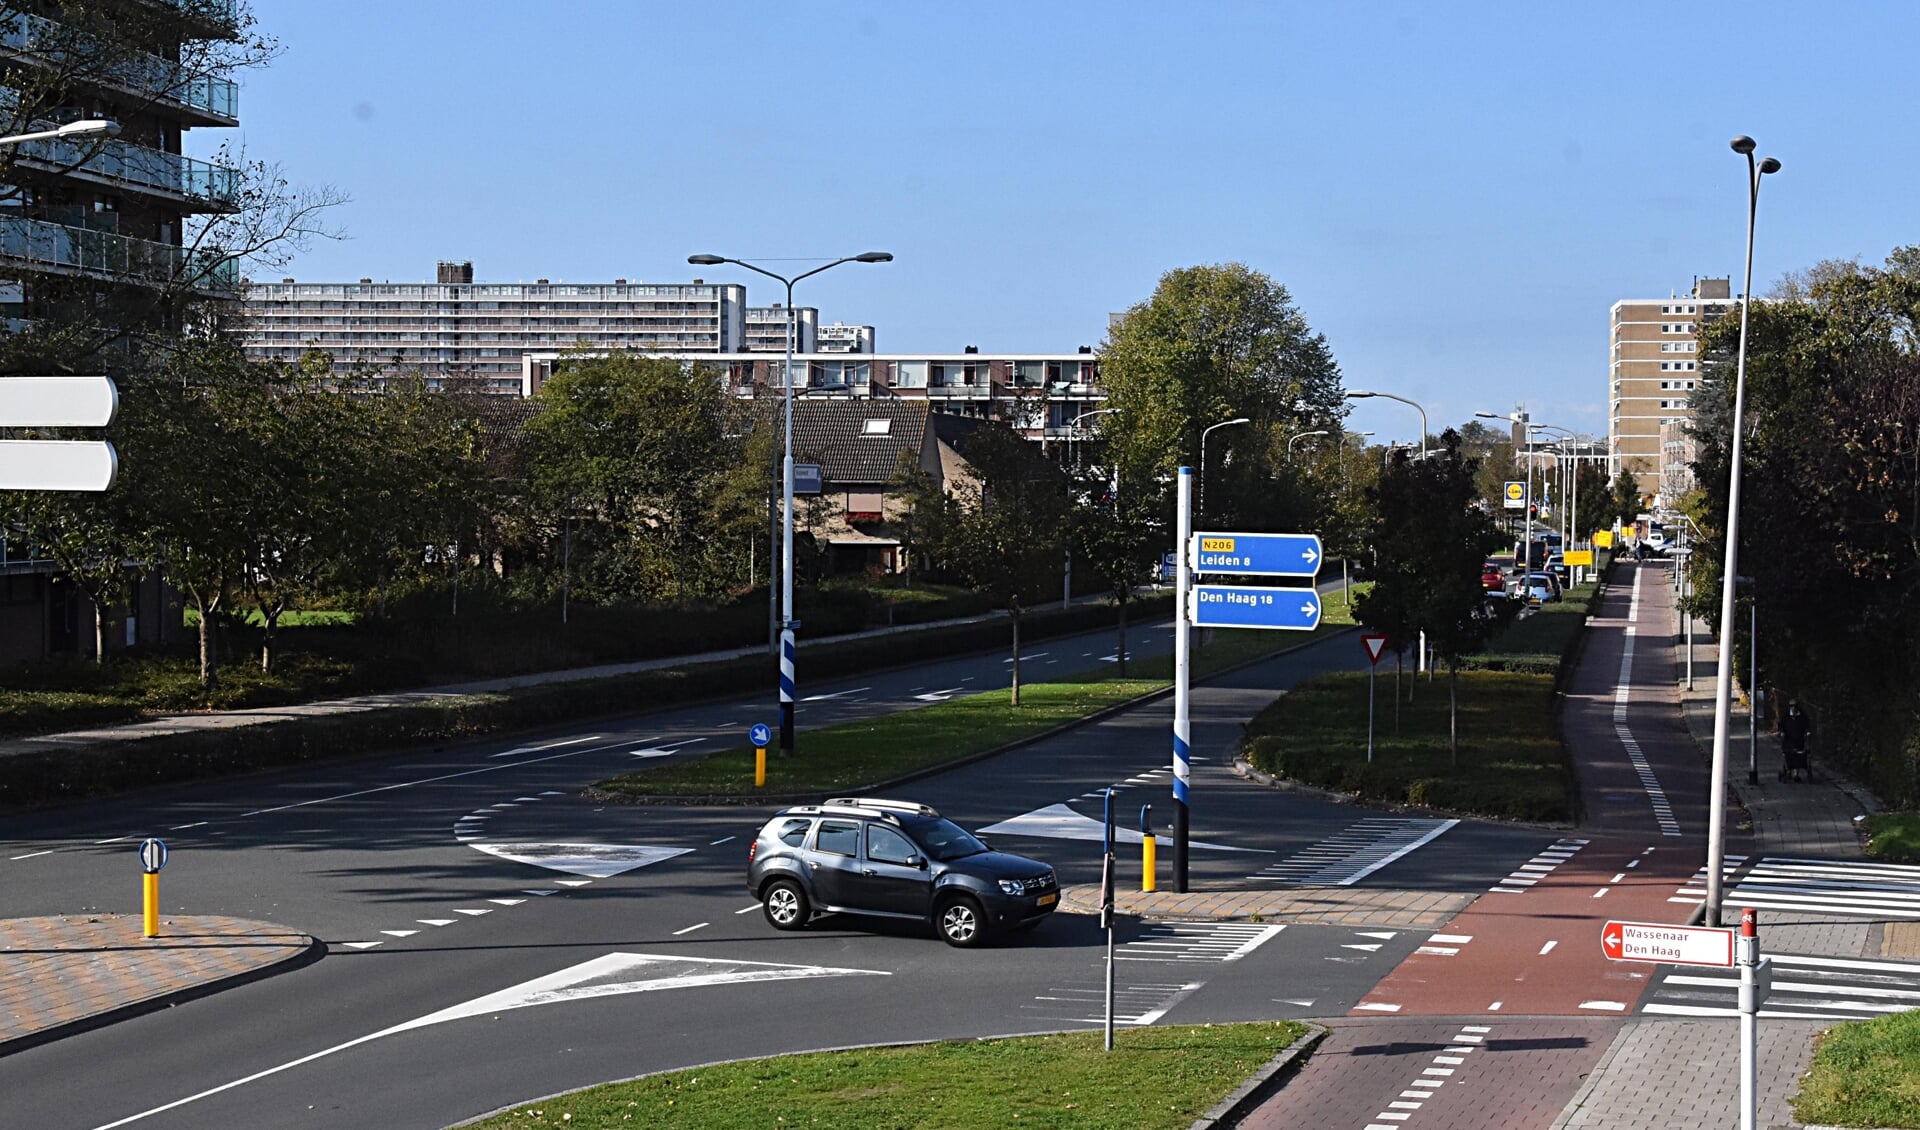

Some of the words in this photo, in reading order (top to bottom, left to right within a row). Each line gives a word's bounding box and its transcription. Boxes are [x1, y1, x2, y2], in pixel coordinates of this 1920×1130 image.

[1204, 541, 1232, 549] N206
[1201, 554, 1239, 566] Leiden
[1243, 557, 1251, 566] 8
[1200, 592, 1223, 602] Den
[1227, 593, 1257, 606] Haag
[1261, 595, 1273, 604] 18
[1625, 928, 1689, 941] Wassenaar
[1625, 944, 1647, 954] Den
[1652, 945, 1681, 958] Haag
